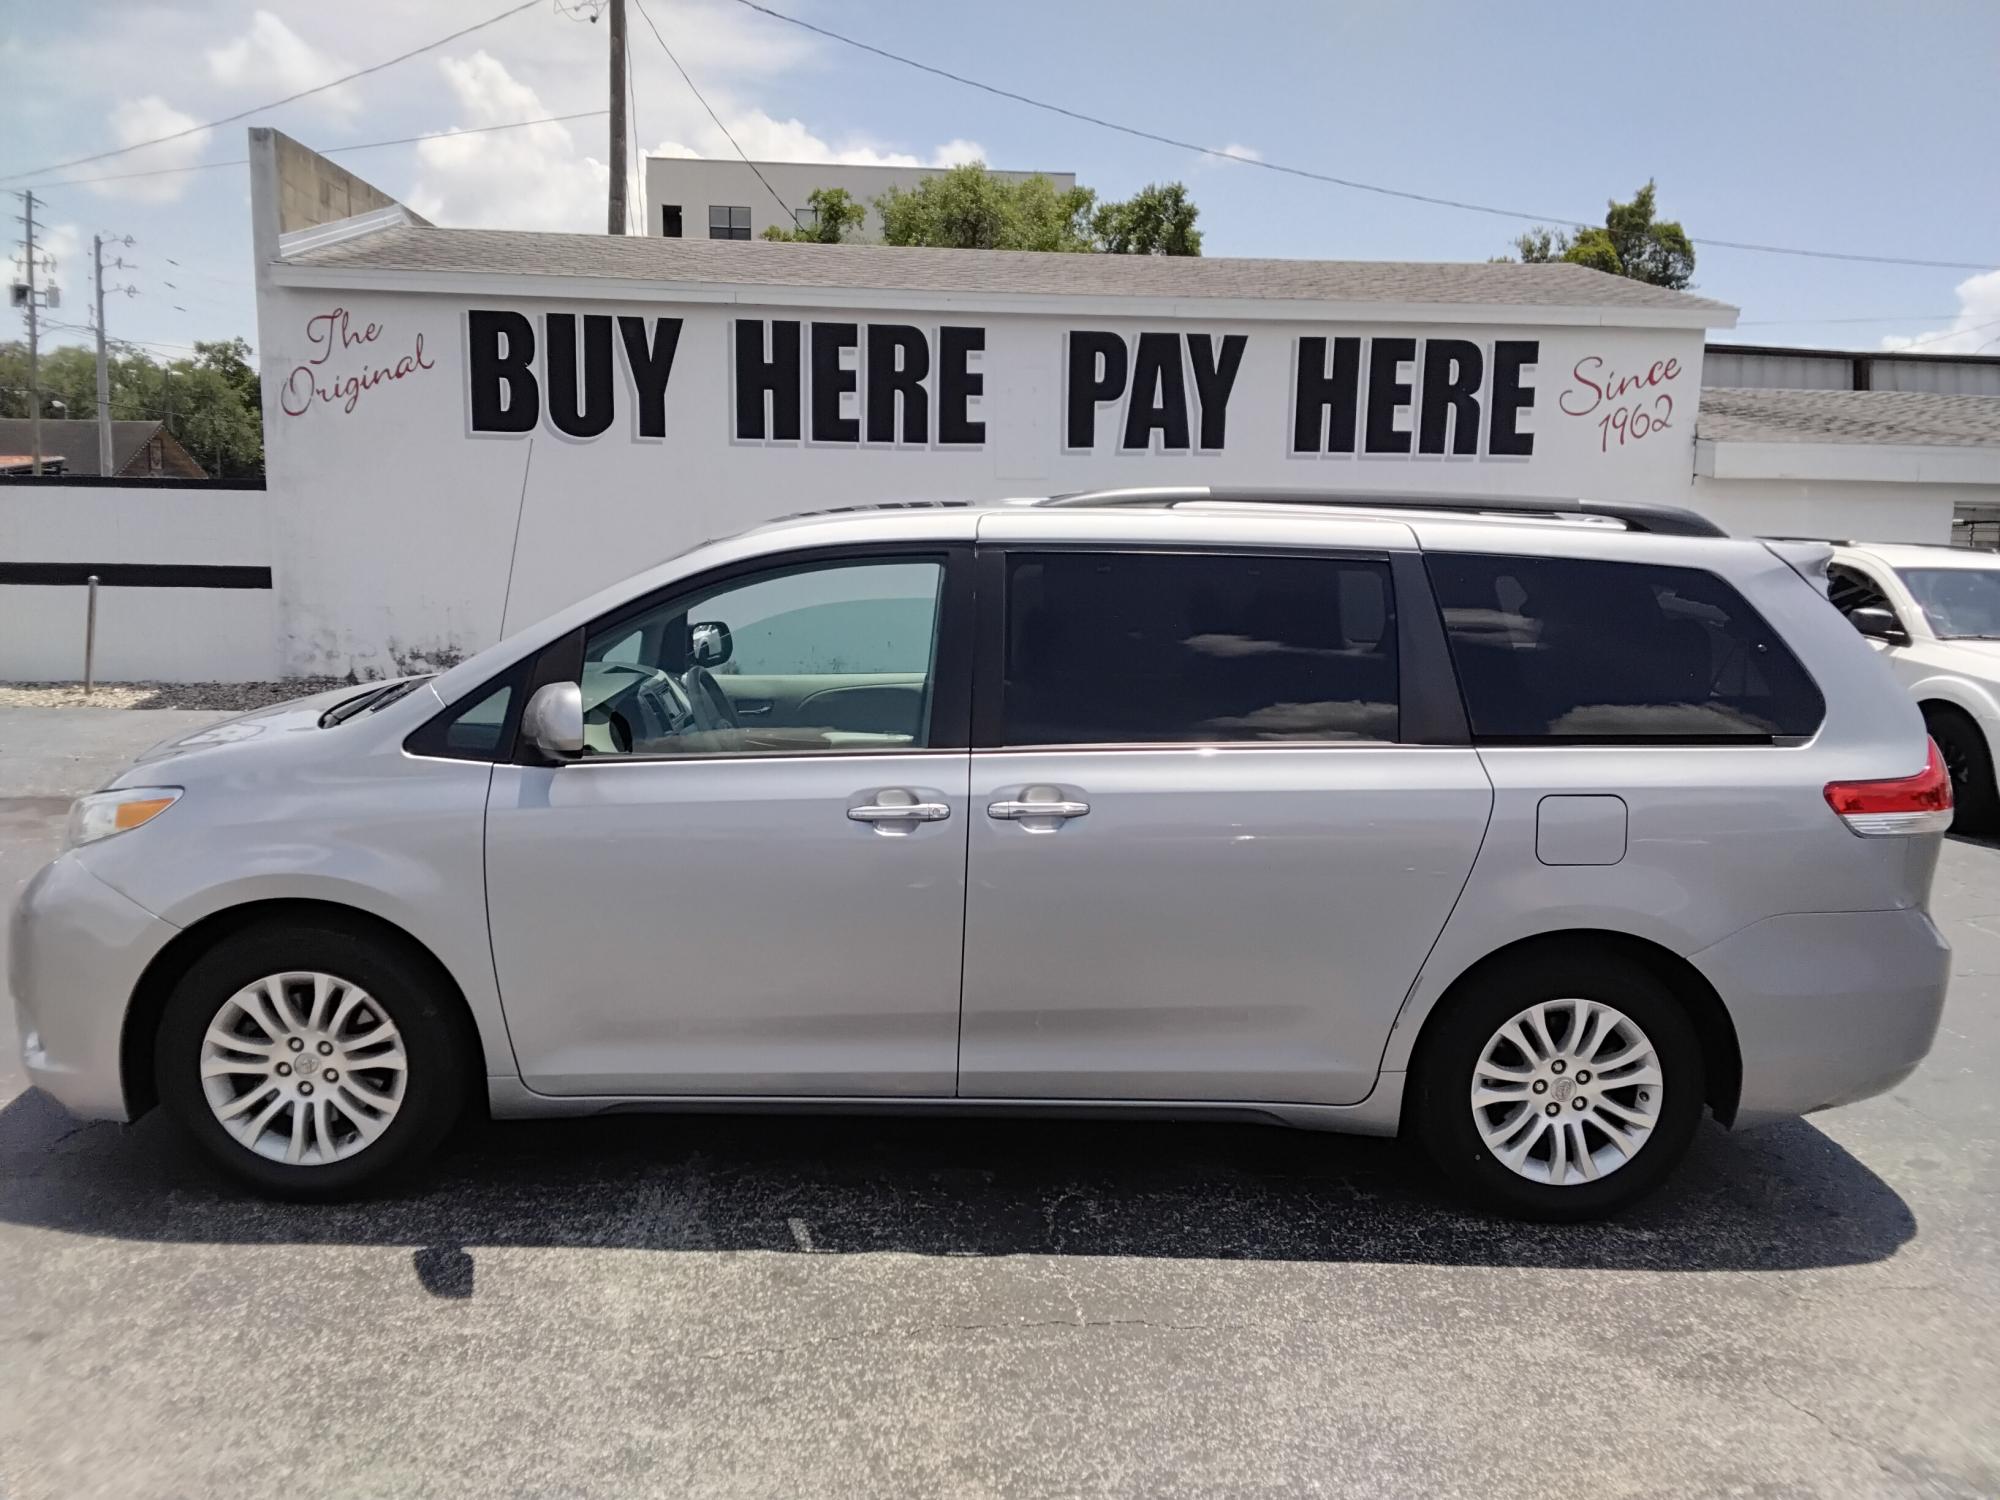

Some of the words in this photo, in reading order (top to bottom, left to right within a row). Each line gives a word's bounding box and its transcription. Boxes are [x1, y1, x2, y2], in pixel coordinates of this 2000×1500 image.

[306, 307, 383, 364] The
[280, 332, 435, 417] Original
[467, 308, 684, 438] BUY
[735, 318, 986, 445] HERE
[1067, 329, 1249, 450] PAY
[1293, 336, 1540, 456] HERE
[1559, 355, 1683, 417] Since
[1598, 394, 1674, 454] 1962
